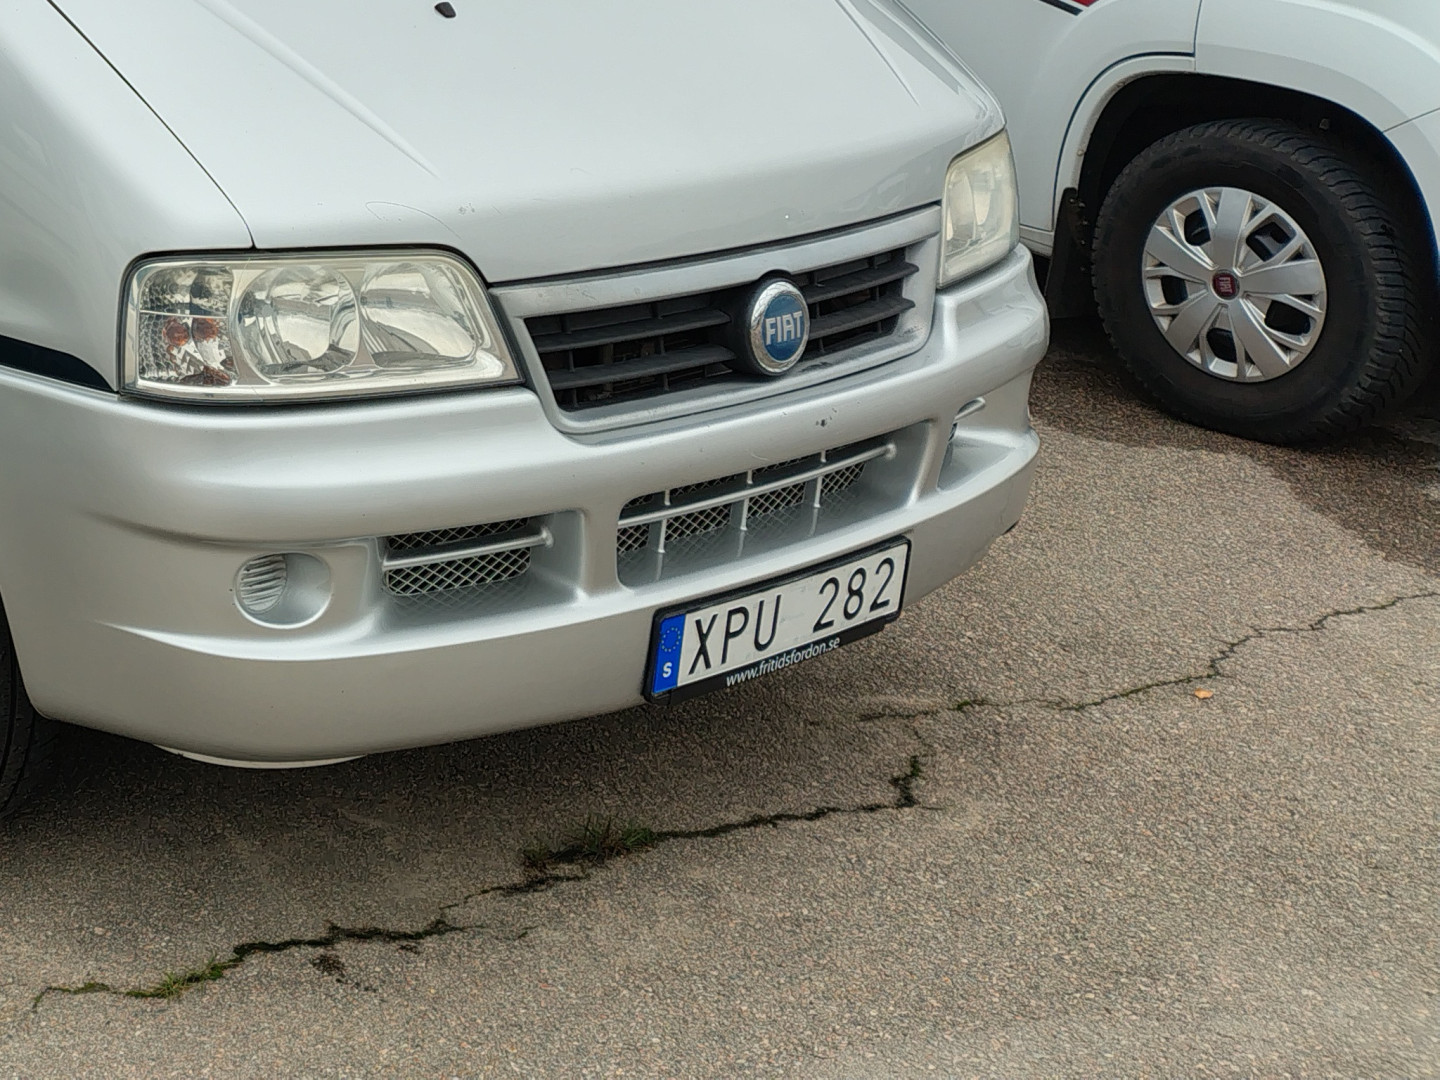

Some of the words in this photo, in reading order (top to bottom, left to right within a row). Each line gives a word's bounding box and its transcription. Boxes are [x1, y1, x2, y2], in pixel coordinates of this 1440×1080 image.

[765, 311, 803, 345] FIAT
[662, 661, 672, 678] S
[688, 594, 783, 676] XPU
[812, 557, 896, 633] 282
[725, 637, 841, 687] www.fritidsfordon.se
